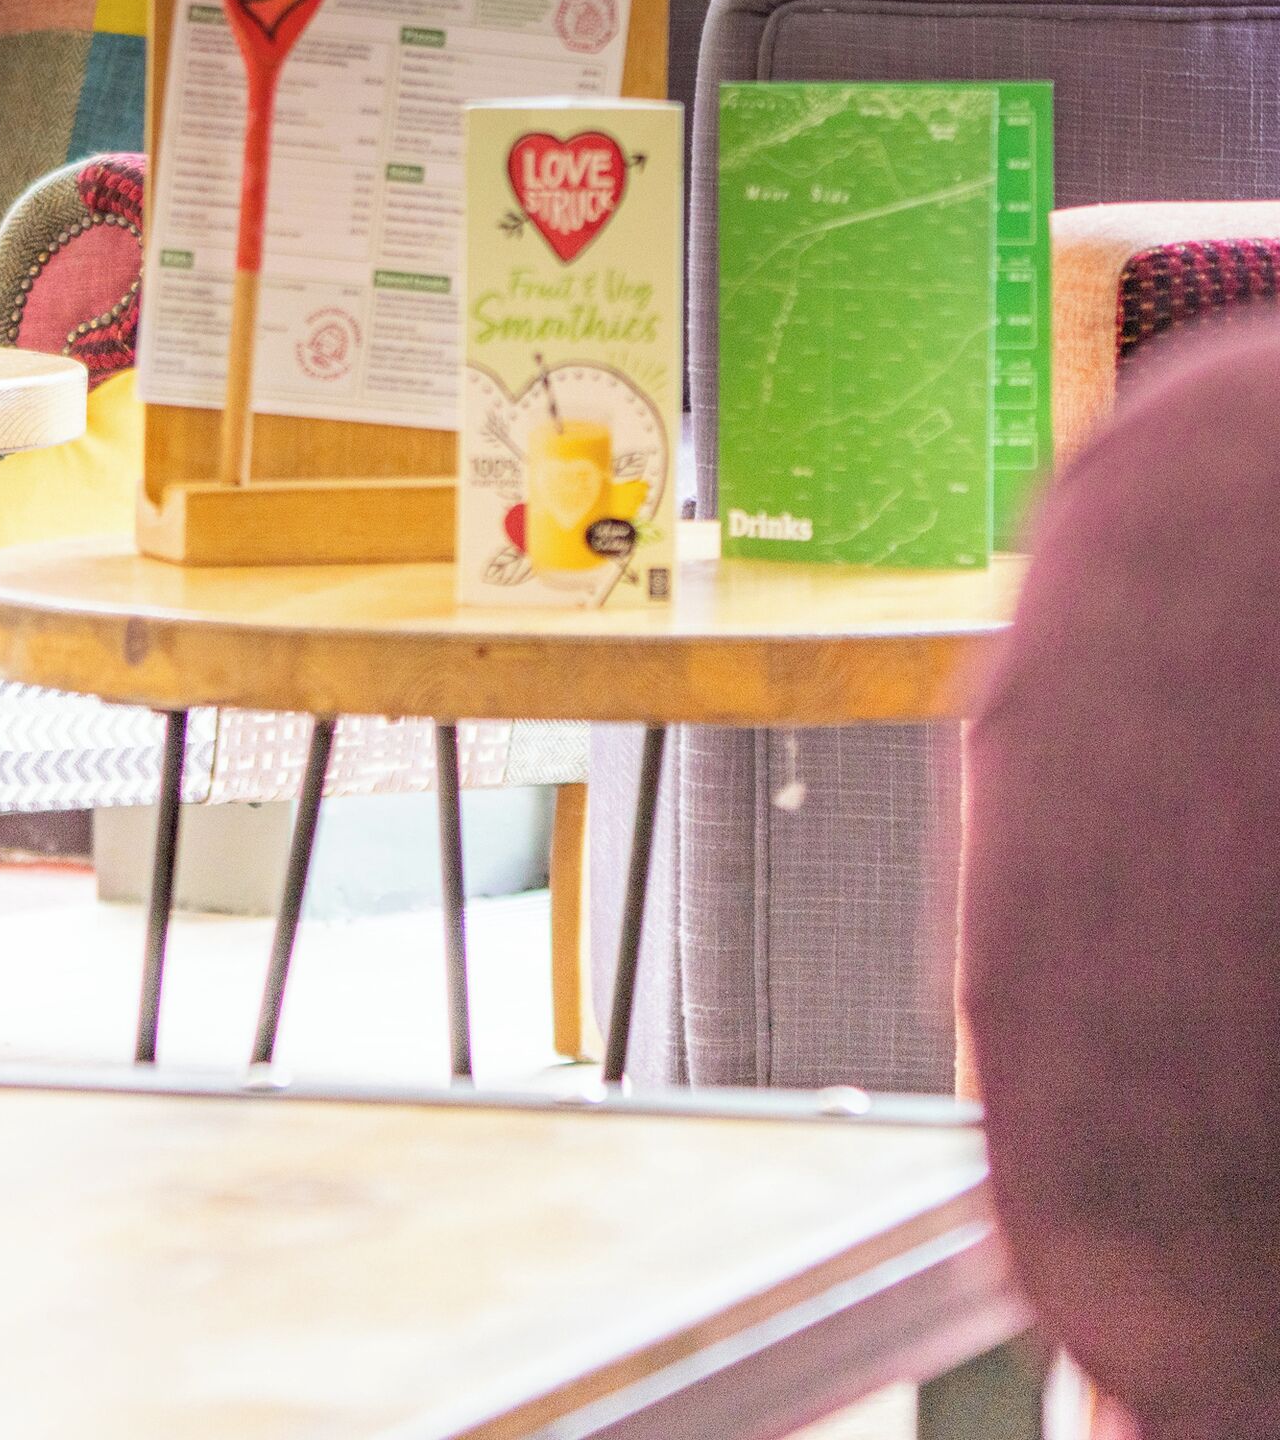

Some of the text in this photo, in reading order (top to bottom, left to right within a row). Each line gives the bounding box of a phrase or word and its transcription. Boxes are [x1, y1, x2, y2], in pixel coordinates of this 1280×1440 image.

[522, 149, 615, 189] LOVE
[525, 188, 614, 236] STRUCK
[510, 266, 574, 300] Fruit
[474, 291, 660, 344] Smoothies
[728, 508, 813, 542] Drinks
